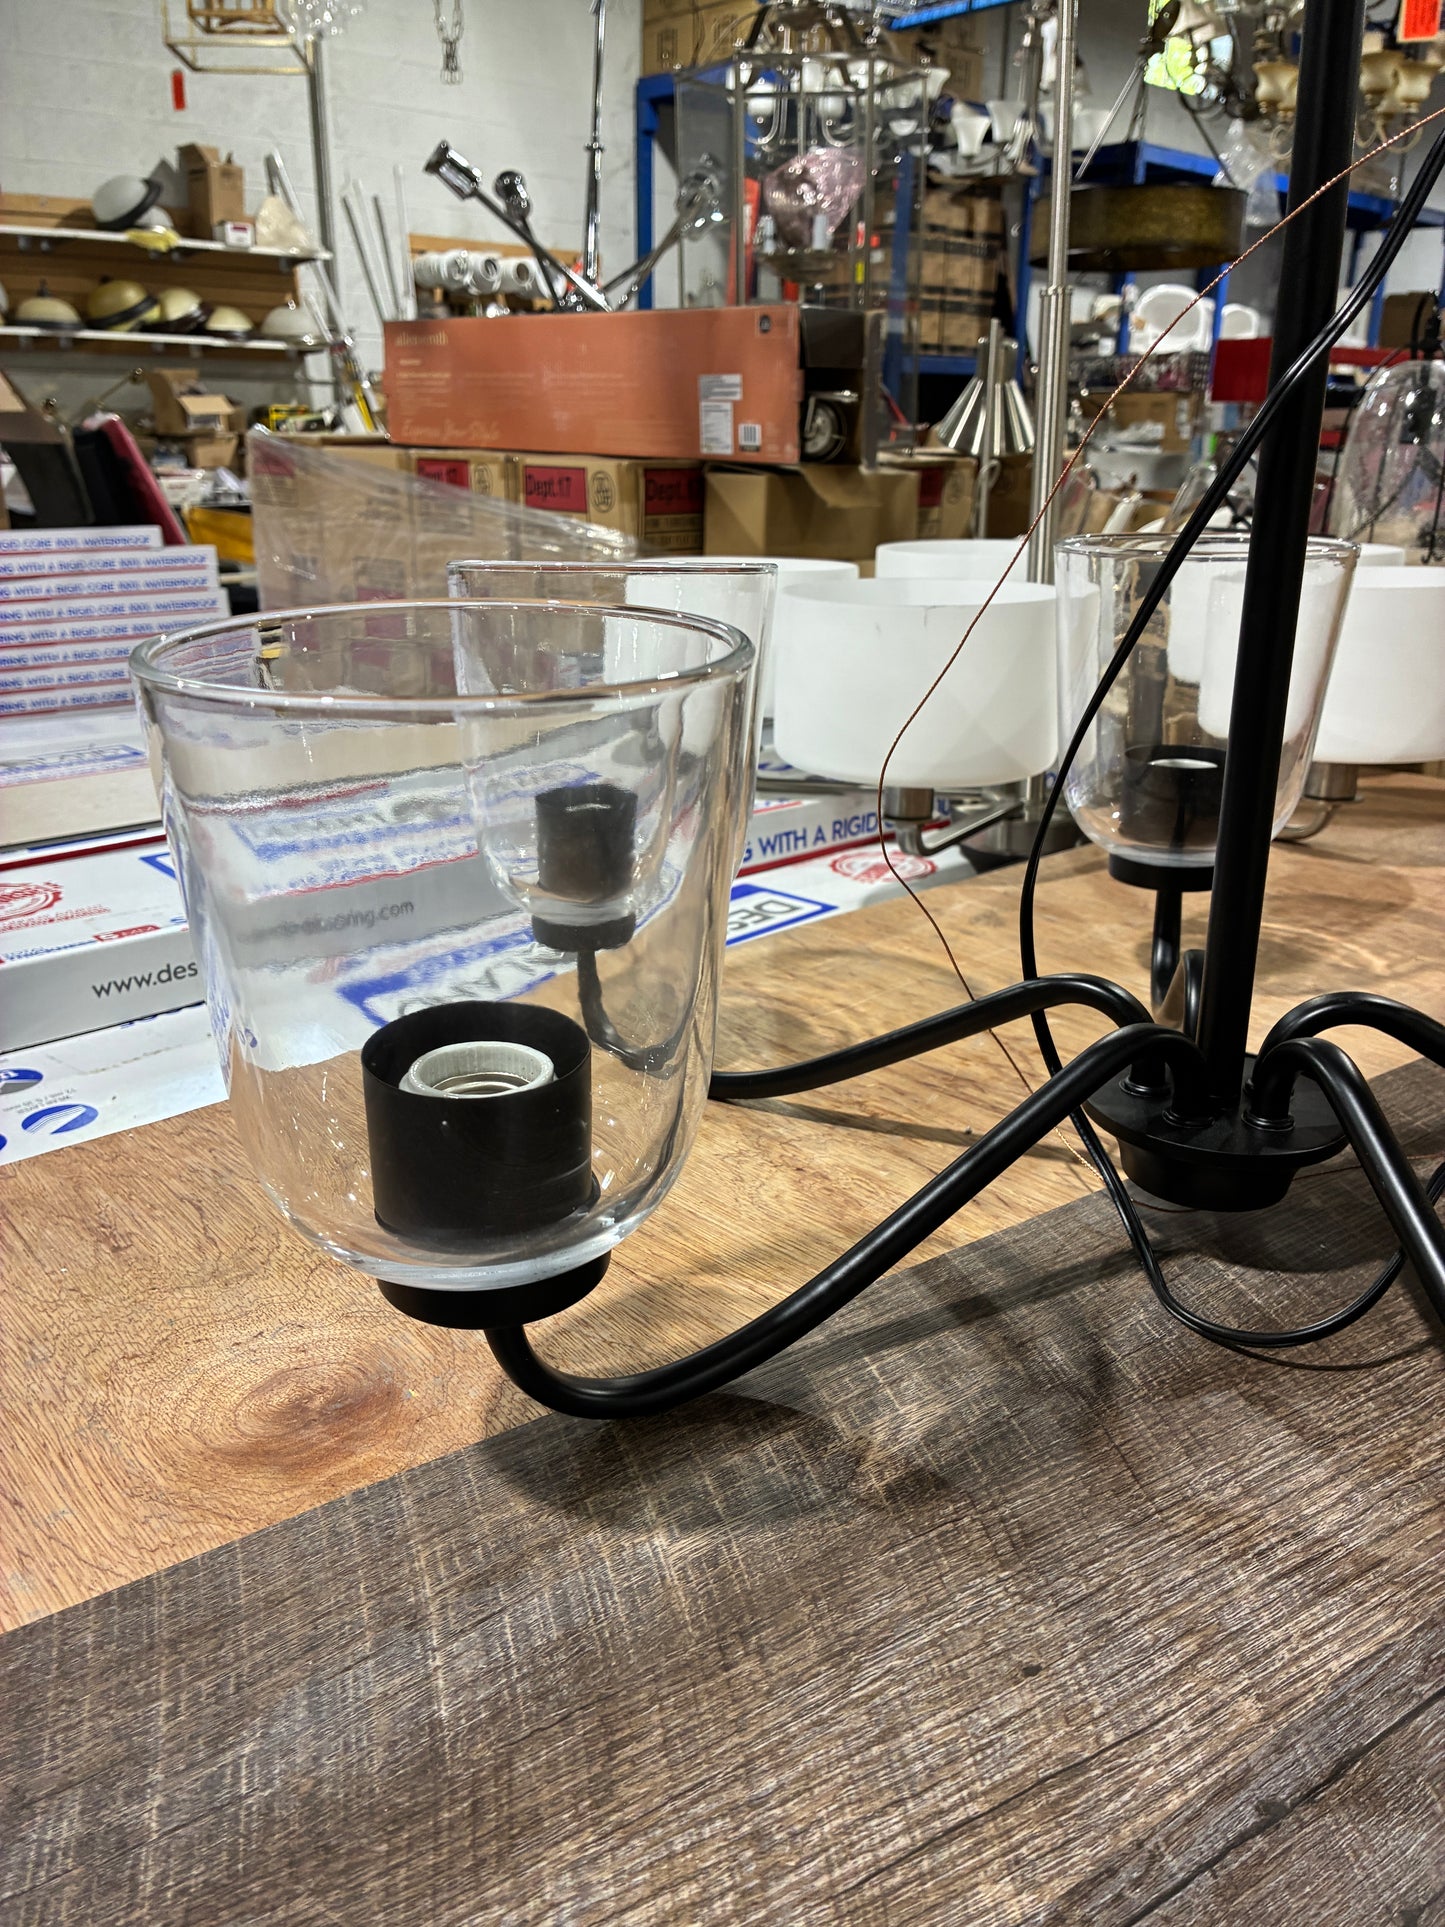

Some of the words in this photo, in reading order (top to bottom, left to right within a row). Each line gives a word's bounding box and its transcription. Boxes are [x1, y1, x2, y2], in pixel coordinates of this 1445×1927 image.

[758, 827, 807, 857] WITH
[812, 824, 827, 847] A
[831, 812, 879, 842] RIGID
[91, 962, 199, 998] www.des
